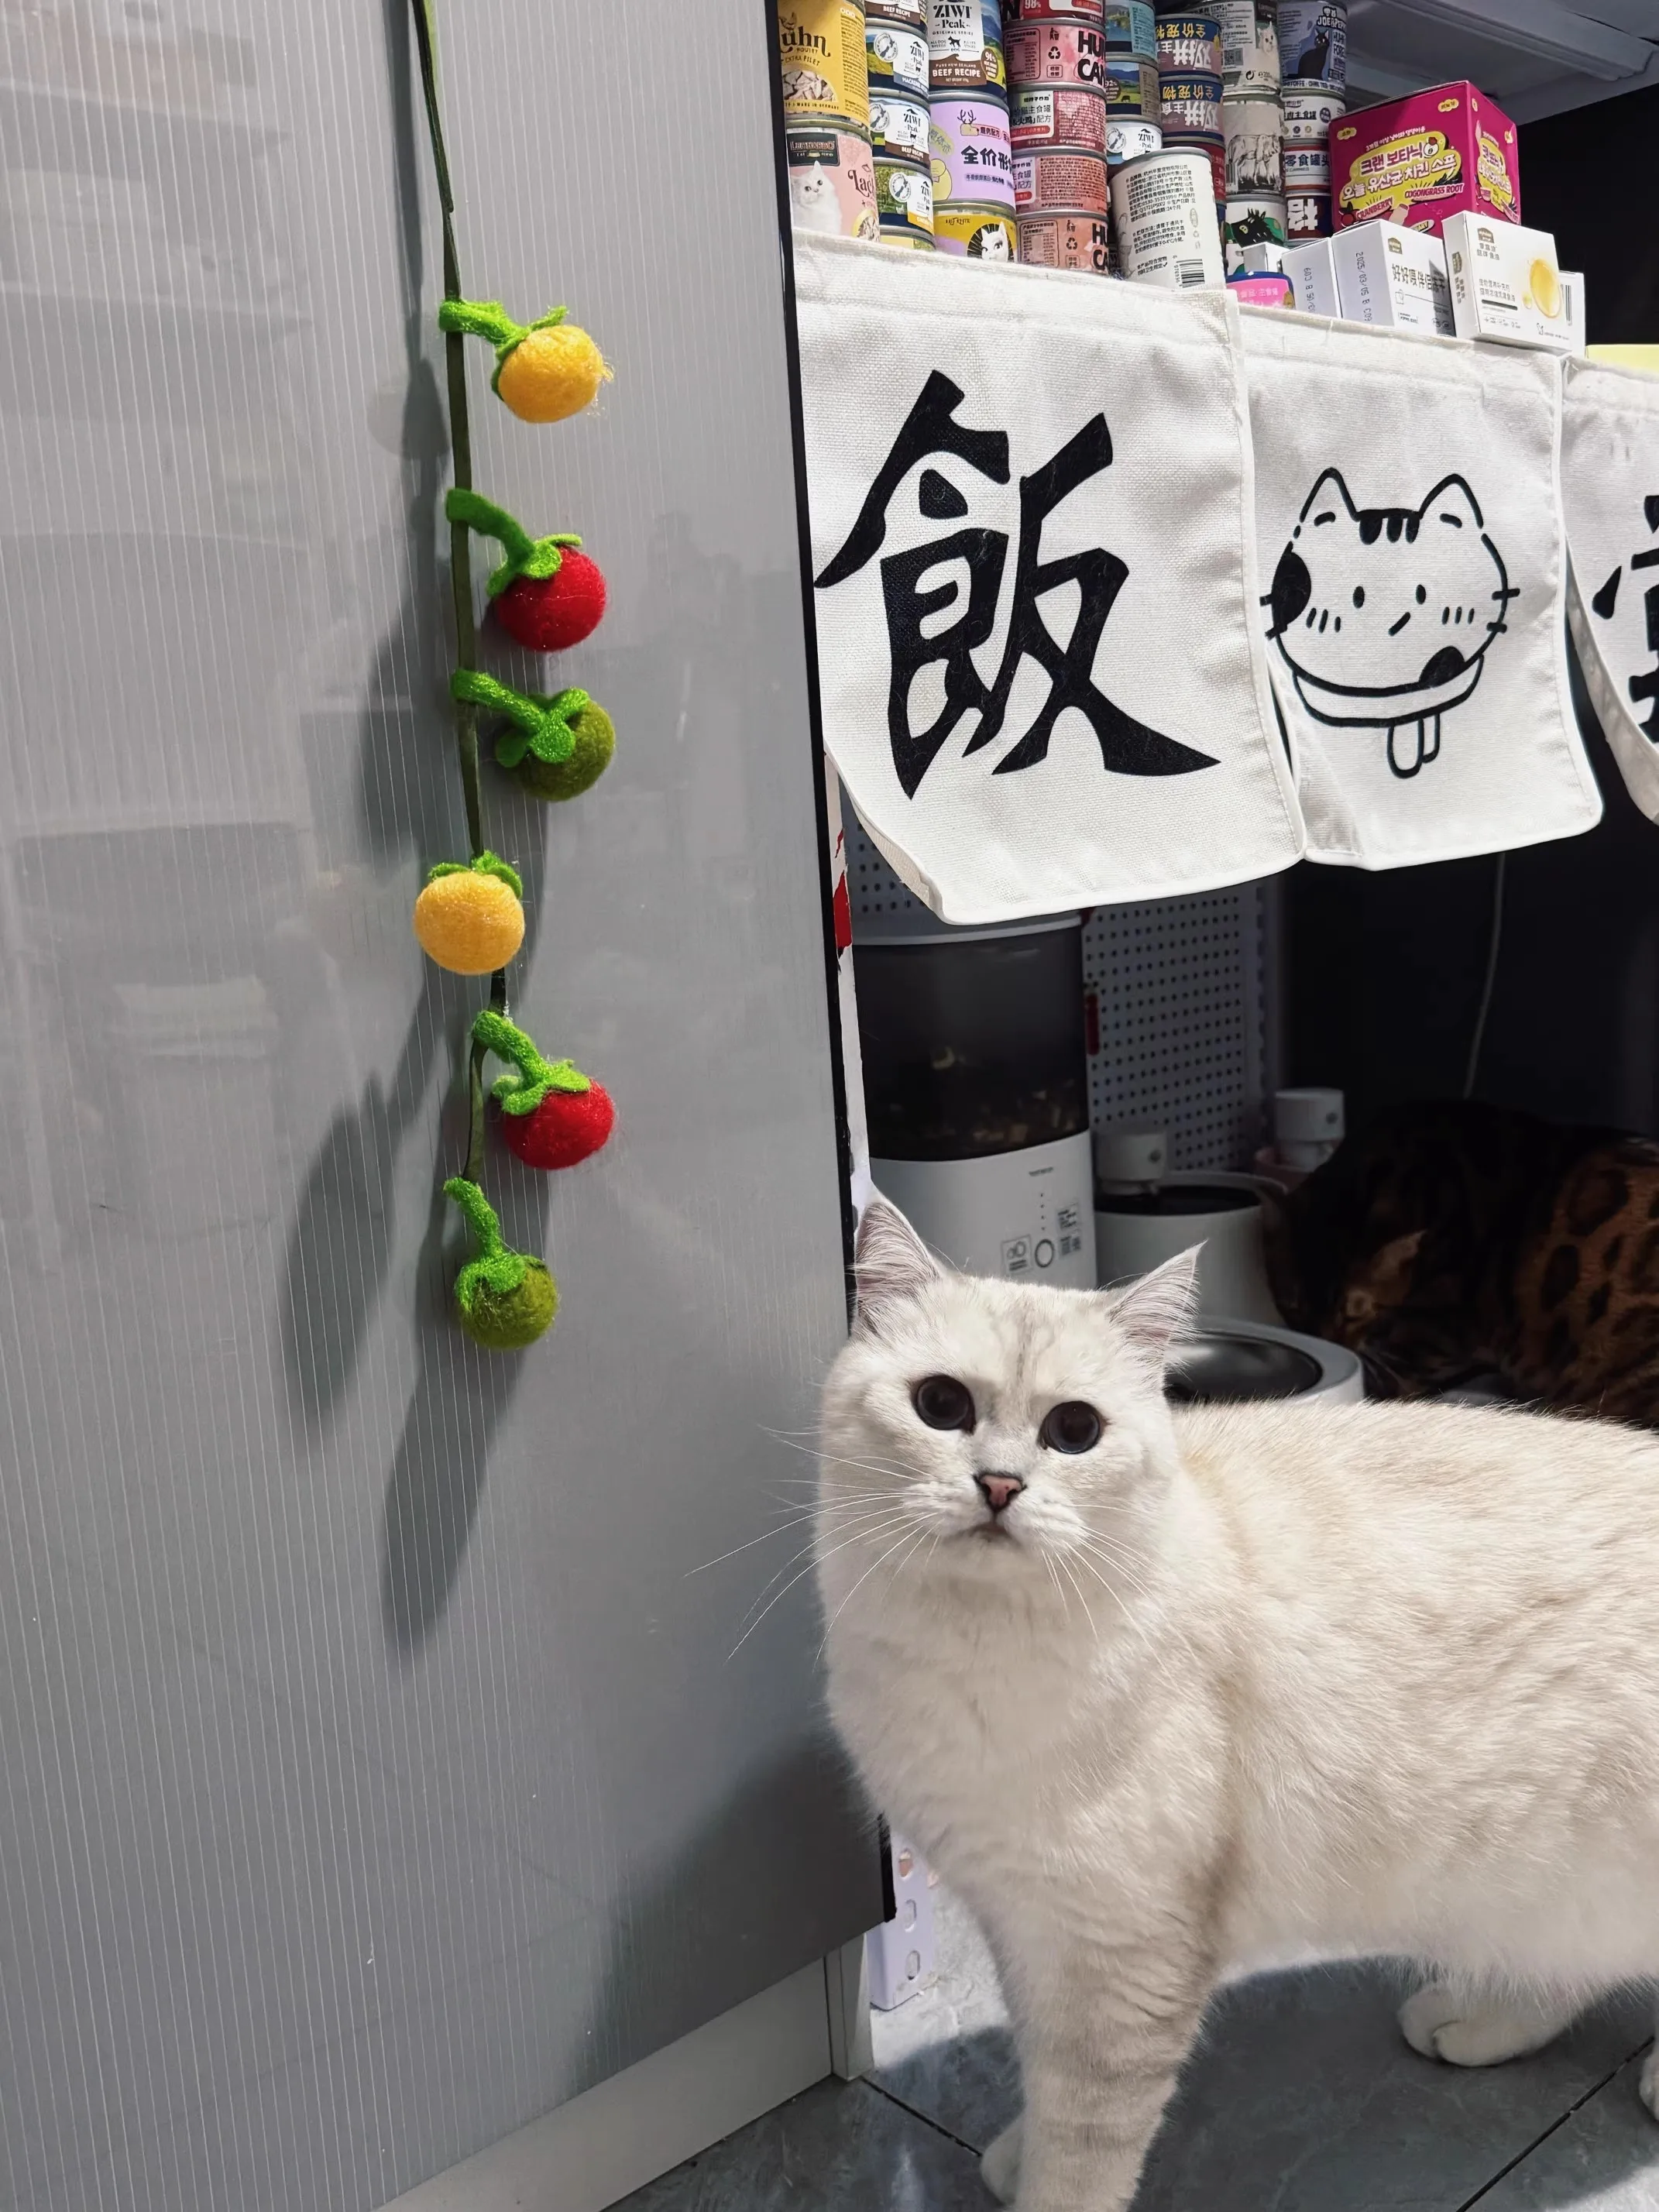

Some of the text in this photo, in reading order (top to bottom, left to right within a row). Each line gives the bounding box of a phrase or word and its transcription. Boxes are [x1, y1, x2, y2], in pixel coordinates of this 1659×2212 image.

[933, 5, 972, 19] ZIWI
[942, 19, 966, 29] Peak
[932, 69, 953, 77] BEEF
[954, 68, 981, 78] RECIPE
[960, 146, 1012, 173] 全价形
[1361, 142, 1424, 176] 크랜 보타닉
[1342, 183, 1366, 201] 오늘
[1367, 169, 1403, 194] 유산균
[1404, 161, 1431, 181] 치킨
[1431, 154, 1457, 173] 스프
[1445, 183, 1464, 194] ROOT
[1356, 197, 1393, 220] CRANBERRY
[813, 369, 1222, 800] 飯
